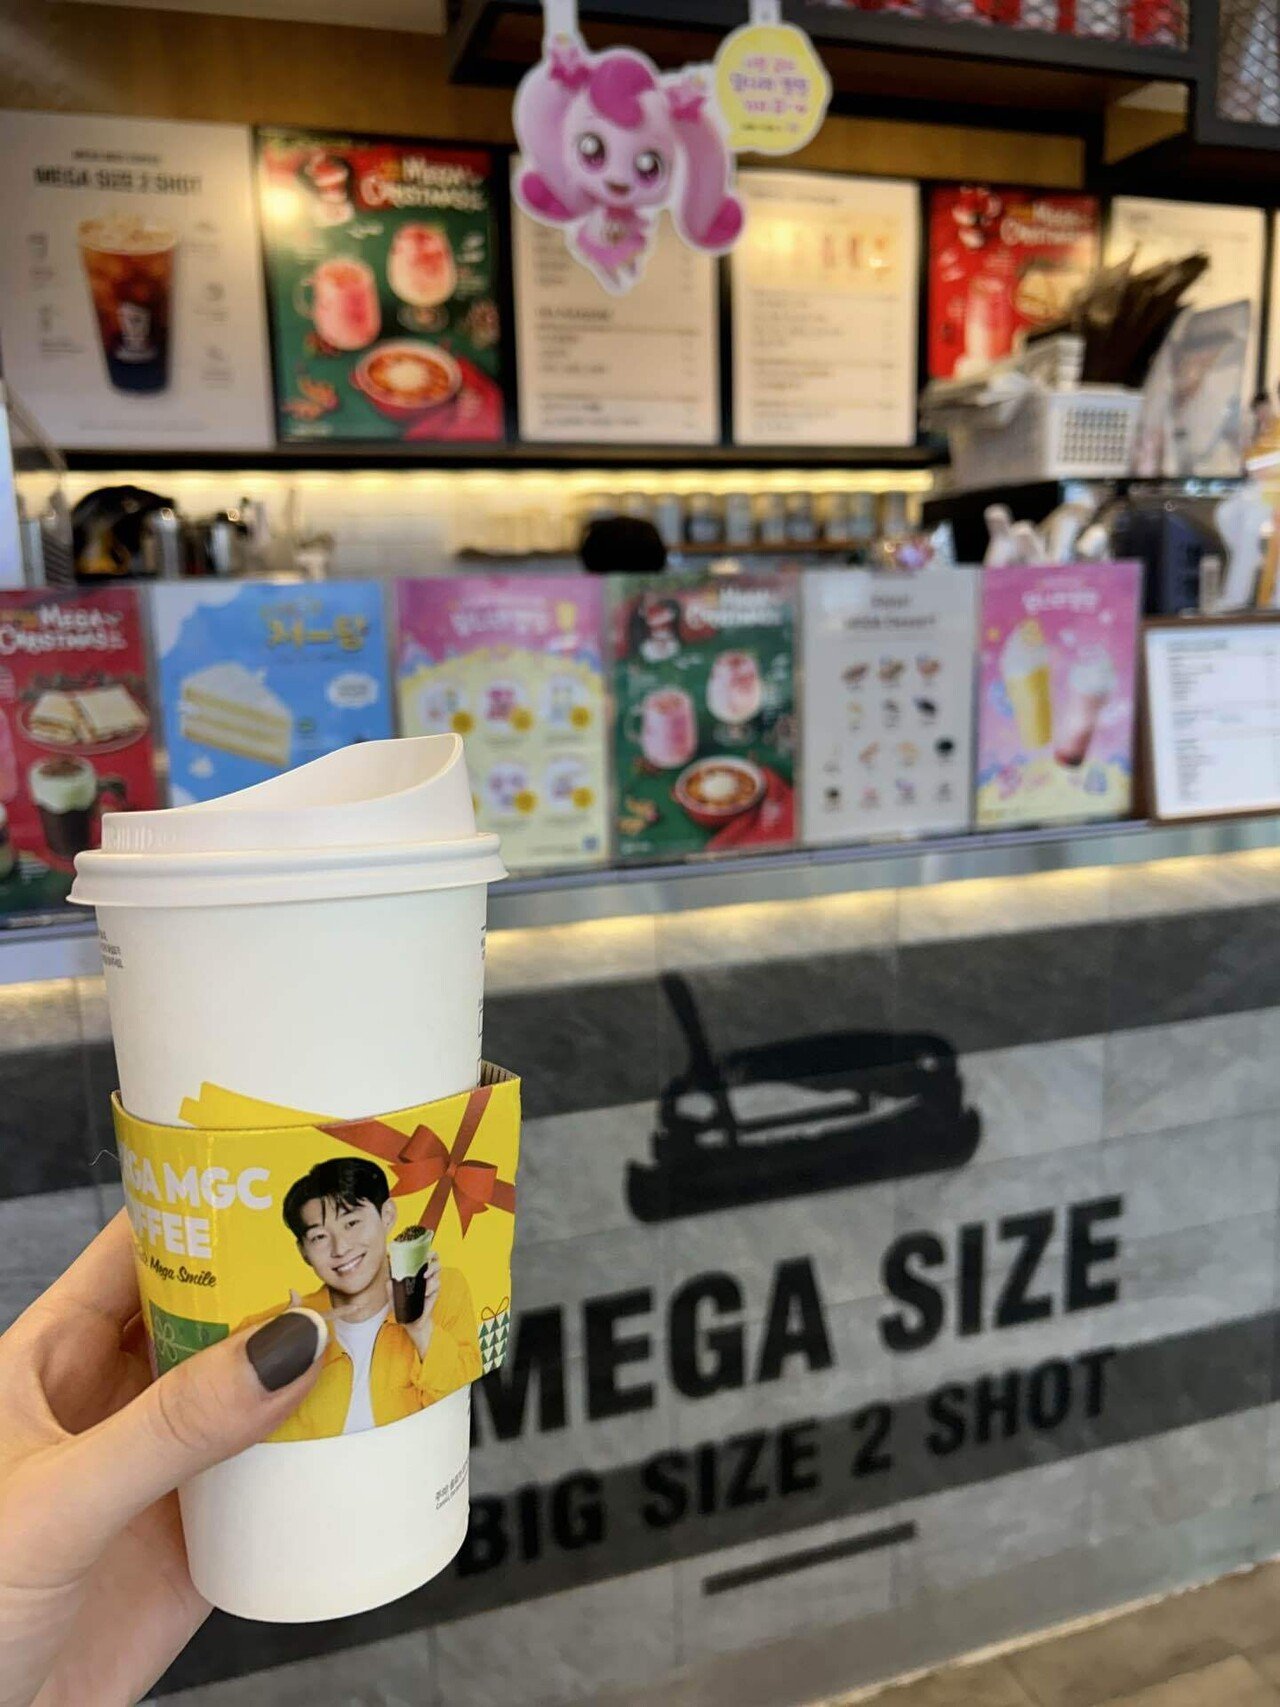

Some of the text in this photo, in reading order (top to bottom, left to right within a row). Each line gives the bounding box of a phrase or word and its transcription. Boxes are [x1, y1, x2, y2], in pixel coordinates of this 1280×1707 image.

[163, 1162, 273, 1210] MGC
[177, 1265, 217, 1287] Smile
[470, 1195, 1123, 1448] MEGA SIZE
[455, 1468, 608, 1578] BIG
[640, 1419, 821, 1530] SIZE
[850, 1405, 893, 1476] 2
[923, 1347, 1117, 1456] SHOT
